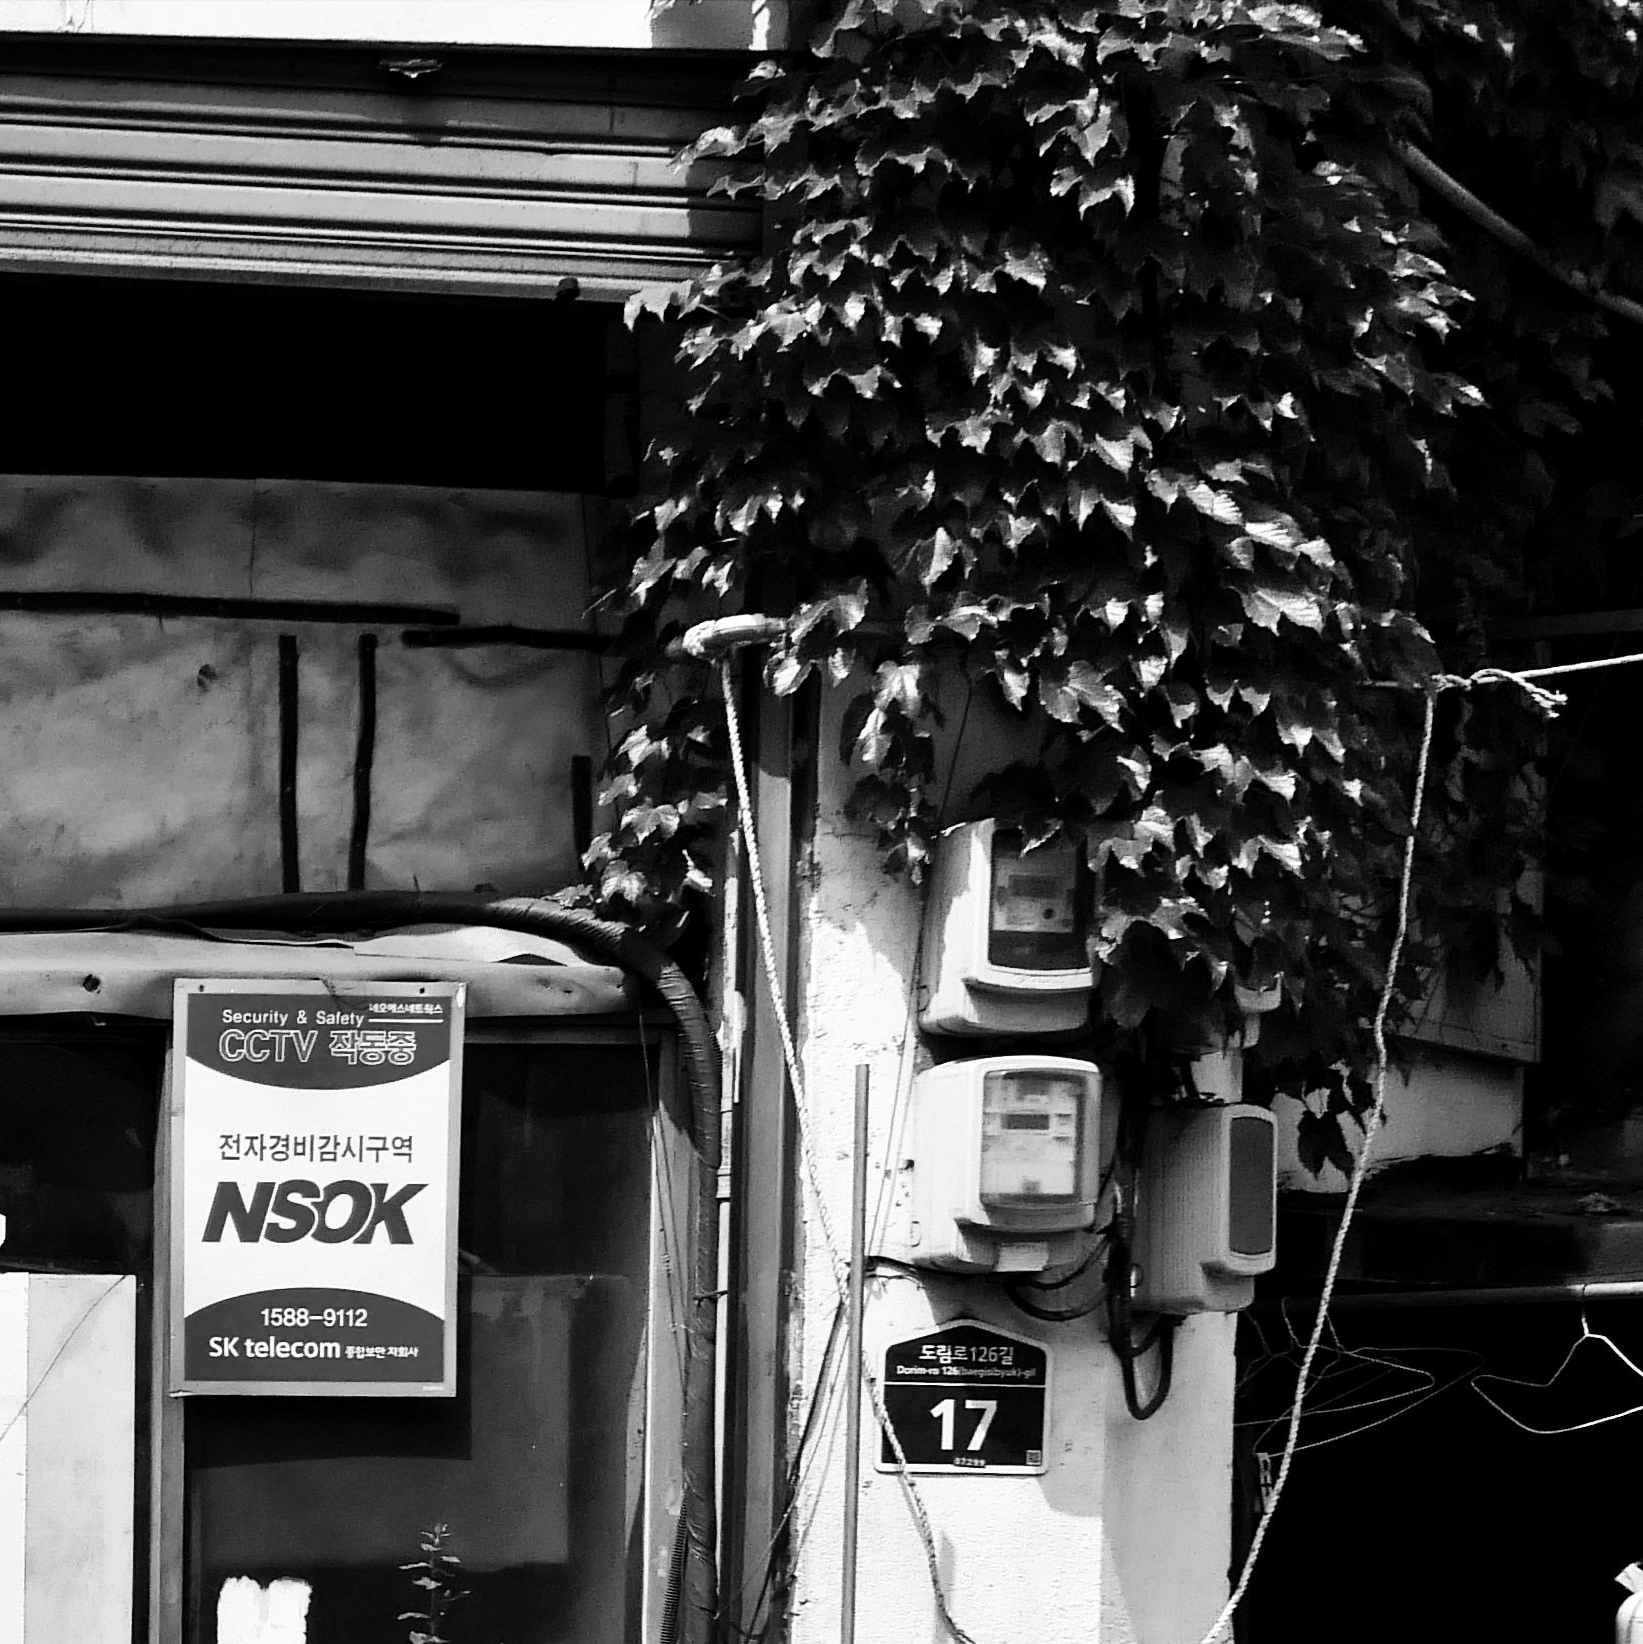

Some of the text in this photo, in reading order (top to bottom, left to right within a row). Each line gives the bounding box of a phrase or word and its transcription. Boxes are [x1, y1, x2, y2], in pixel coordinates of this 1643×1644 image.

[222, 1009, 365, 1028] Security & Safety
[219, 1029, 417, 1066] CCTV 작동중
[219, 1133, 413, 1163] 전자경비감시구역
[201, 1179, 429, 1245] NSOK
[261, 1308, 368, 1328] 1588-9112
[209, 1337, 239, 1358] SK
[245, 1336, 341, 1359] telecom
[930, 1398, 998, 1451] 17
